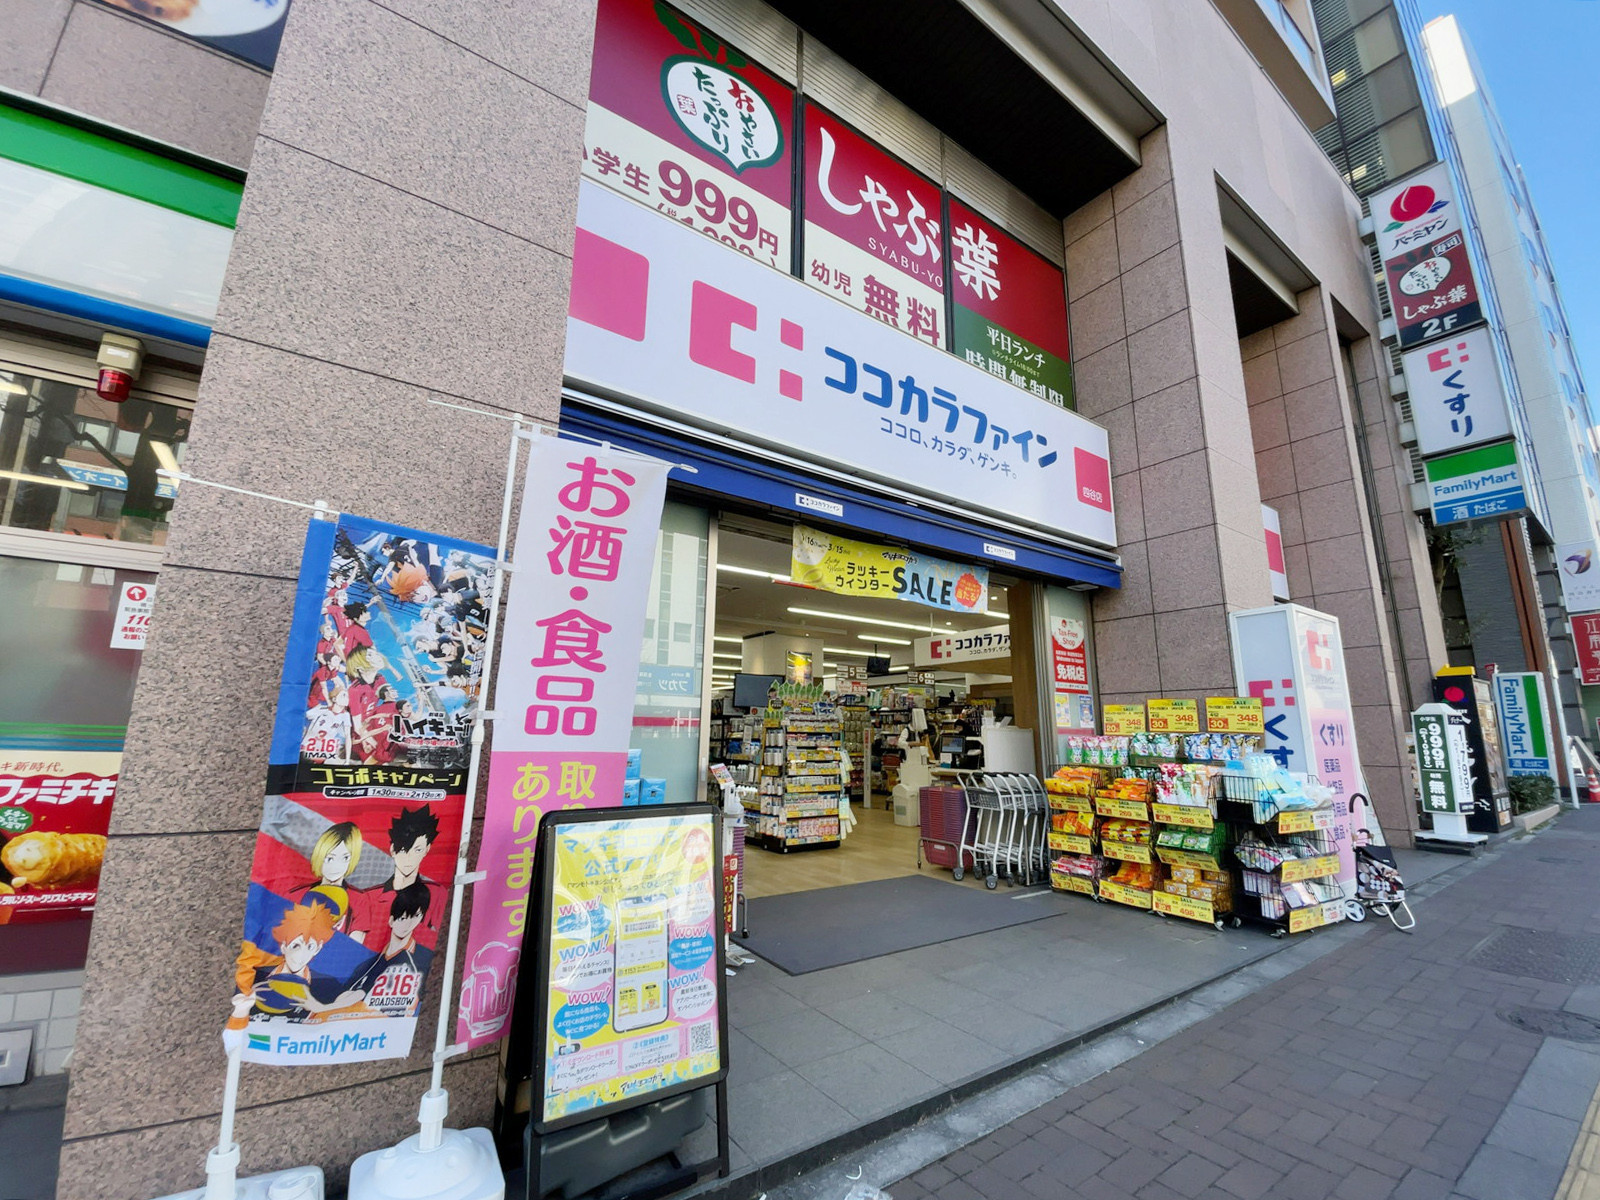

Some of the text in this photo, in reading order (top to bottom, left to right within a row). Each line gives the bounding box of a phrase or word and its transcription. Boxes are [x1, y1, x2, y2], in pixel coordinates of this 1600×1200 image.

[692, 65, 730, 154] たっぷり
[727, 78, 760, 158] おやさい
[867, 236, 944, 288] SYABU-YO
[811, 258, 941, 346] 幼児 無料
[1403, 284, 1468, 320] しゃぶ葉
[1422, 313, 1458, 339] 2F
[986, 325, 1047, 370] 平日ランチ
[825, 346, 1058, 469] ココカラファイン
[1442, 369, 1473, 437] くすり
[1433, 470, 1517, 497] FamilyMart
[1452, 499, 1508, 520] 酒 たばこ
[835, 575, 890, 590] ウィンター
[847, 562, 890, 578] ラッキー
[523, 456, 636, 736] お酒・食品
[892, 566, 953, 606] SALE
[1174, 714, 1194, 722] 348
[1236, 713, 1259, 722] 348
[1502, 678, 1528, 755] FamilyMart
[306, 737, 336, 753] 2.16
[1320, 724, 1345, 746] くすり
[304, 752, 337, 760] IMAX
[310, 767, 462, 787] コラボキャンペーン
[0, 778, 118, 805] ファミチキ
[501, 761, 550, 938] あります
[371, 974, 414, 997] 2.16
[368, 996, 415, 1007] ROADSHOW
[276, 1031, 387, 1056] FamilyMart
